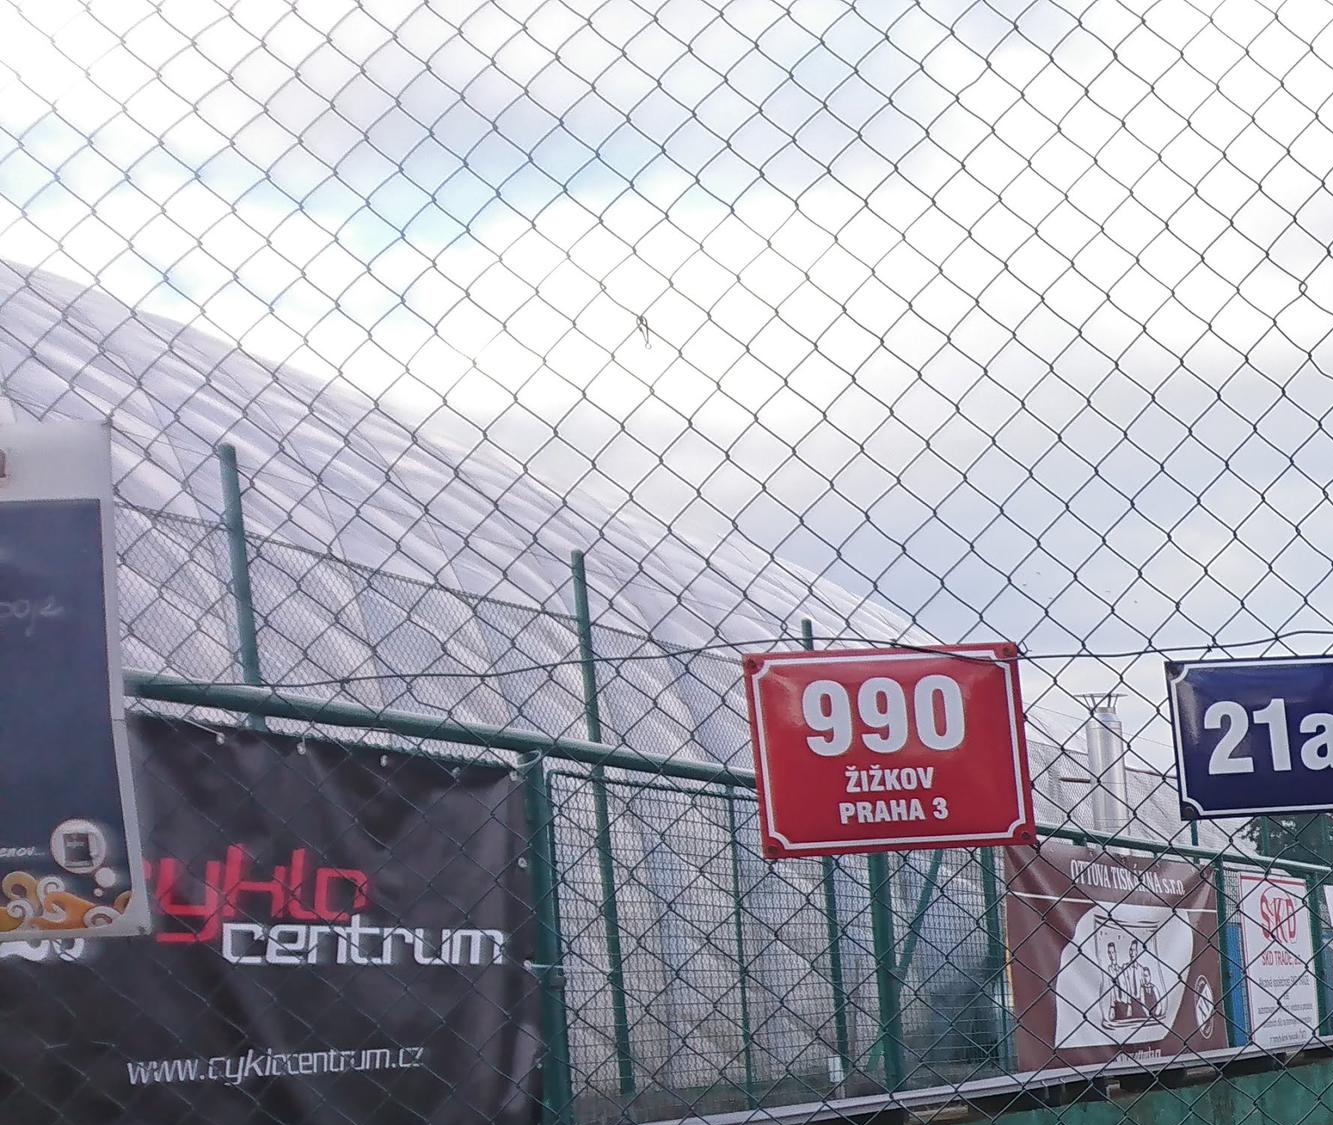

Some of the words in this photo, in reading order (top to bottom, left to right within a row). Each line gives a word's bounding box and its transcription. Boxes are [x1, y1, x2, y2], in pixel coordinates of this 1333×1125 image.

[800, 674, 966, 758] 990
[844, 766, 935, 793] ŽIŽKOV
[839, 801, 926, 825] PRAHA
[932, 797, 949, 821] 3
[144, 843, 369, 944] yklo
[1070, 859, 1112, 889] OTTOVA
[221, 914, 504, 965] centrum
